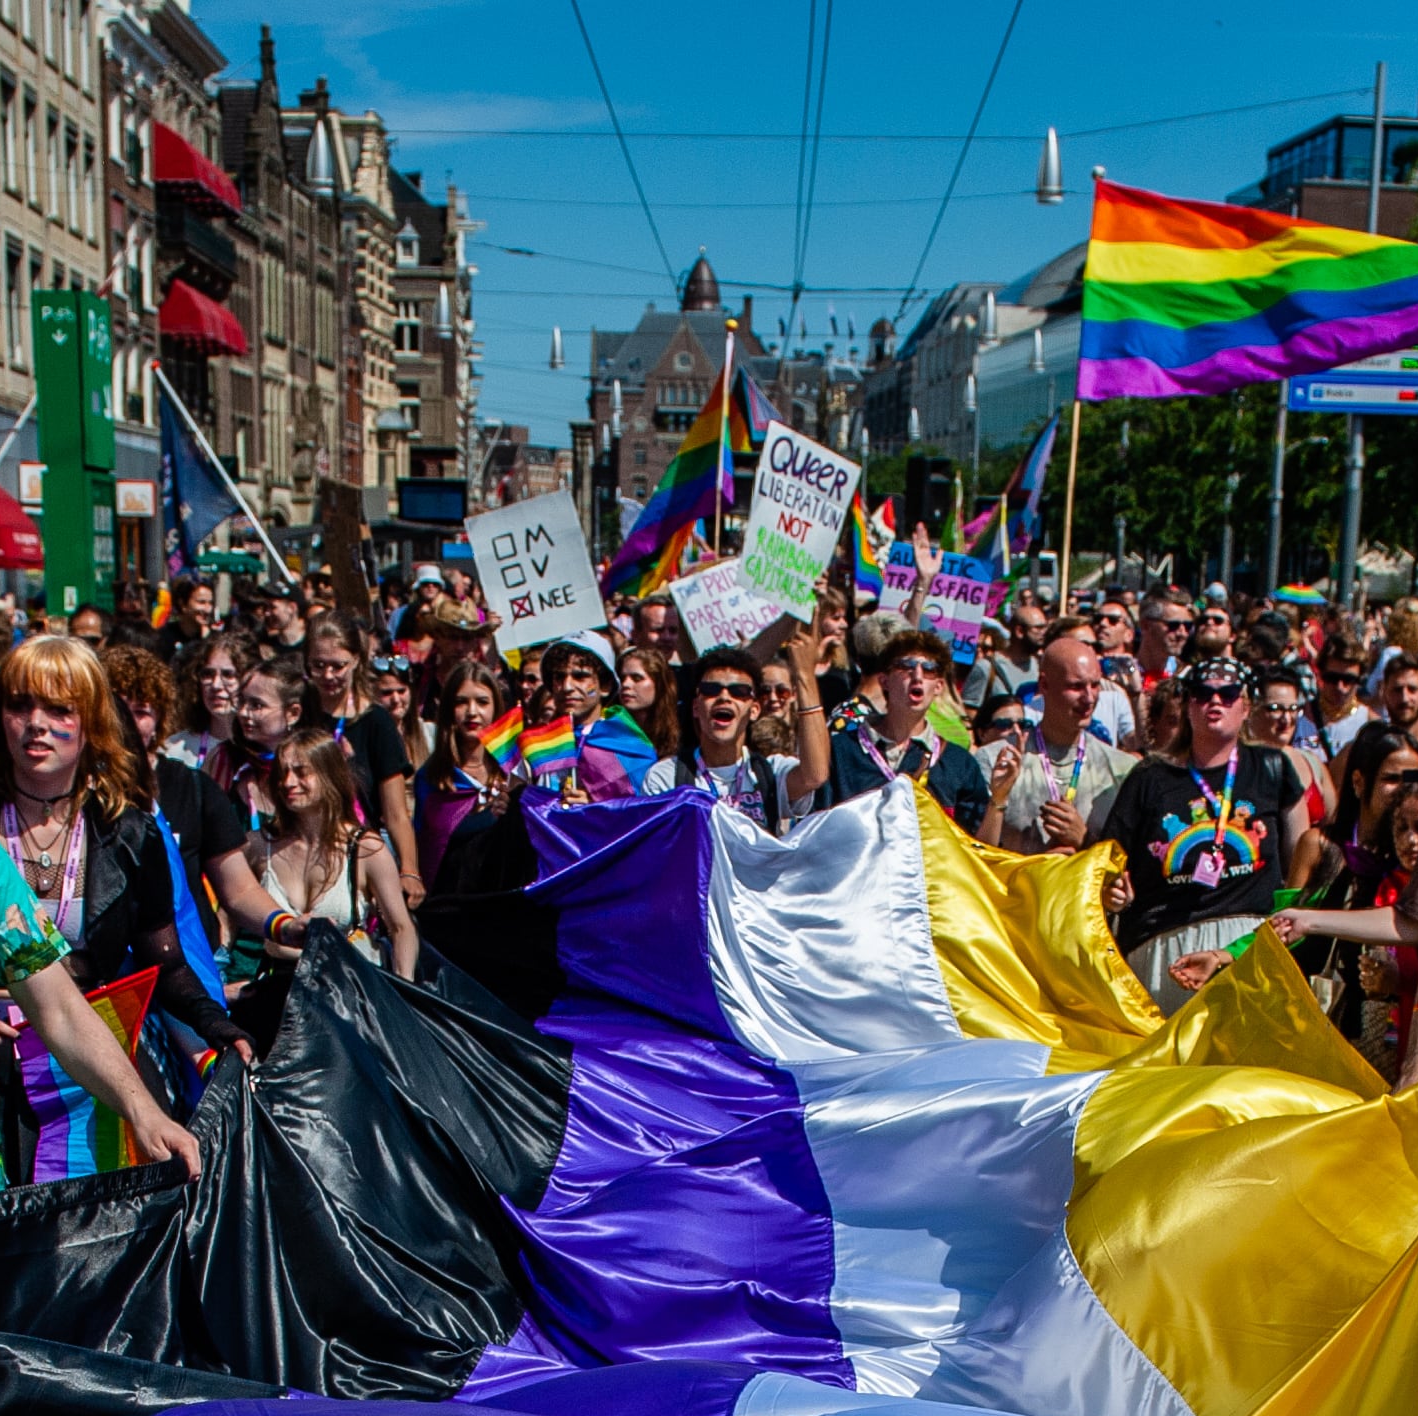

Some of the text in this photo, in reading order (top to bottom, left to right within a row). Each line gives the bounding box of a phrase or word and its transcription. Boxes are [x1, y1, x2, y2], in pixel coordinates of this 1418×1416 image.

[759, 471, 843, 531] LIBERATION
[525, 523, 555, 553] M
[777, 512, 812, 544] NOT
[531, 554, 549, 578] V
[757, 526, 824, 578] RAINBOW
[537, 584, 577, 611] NEE
[686, 600, 726, 632] PART
